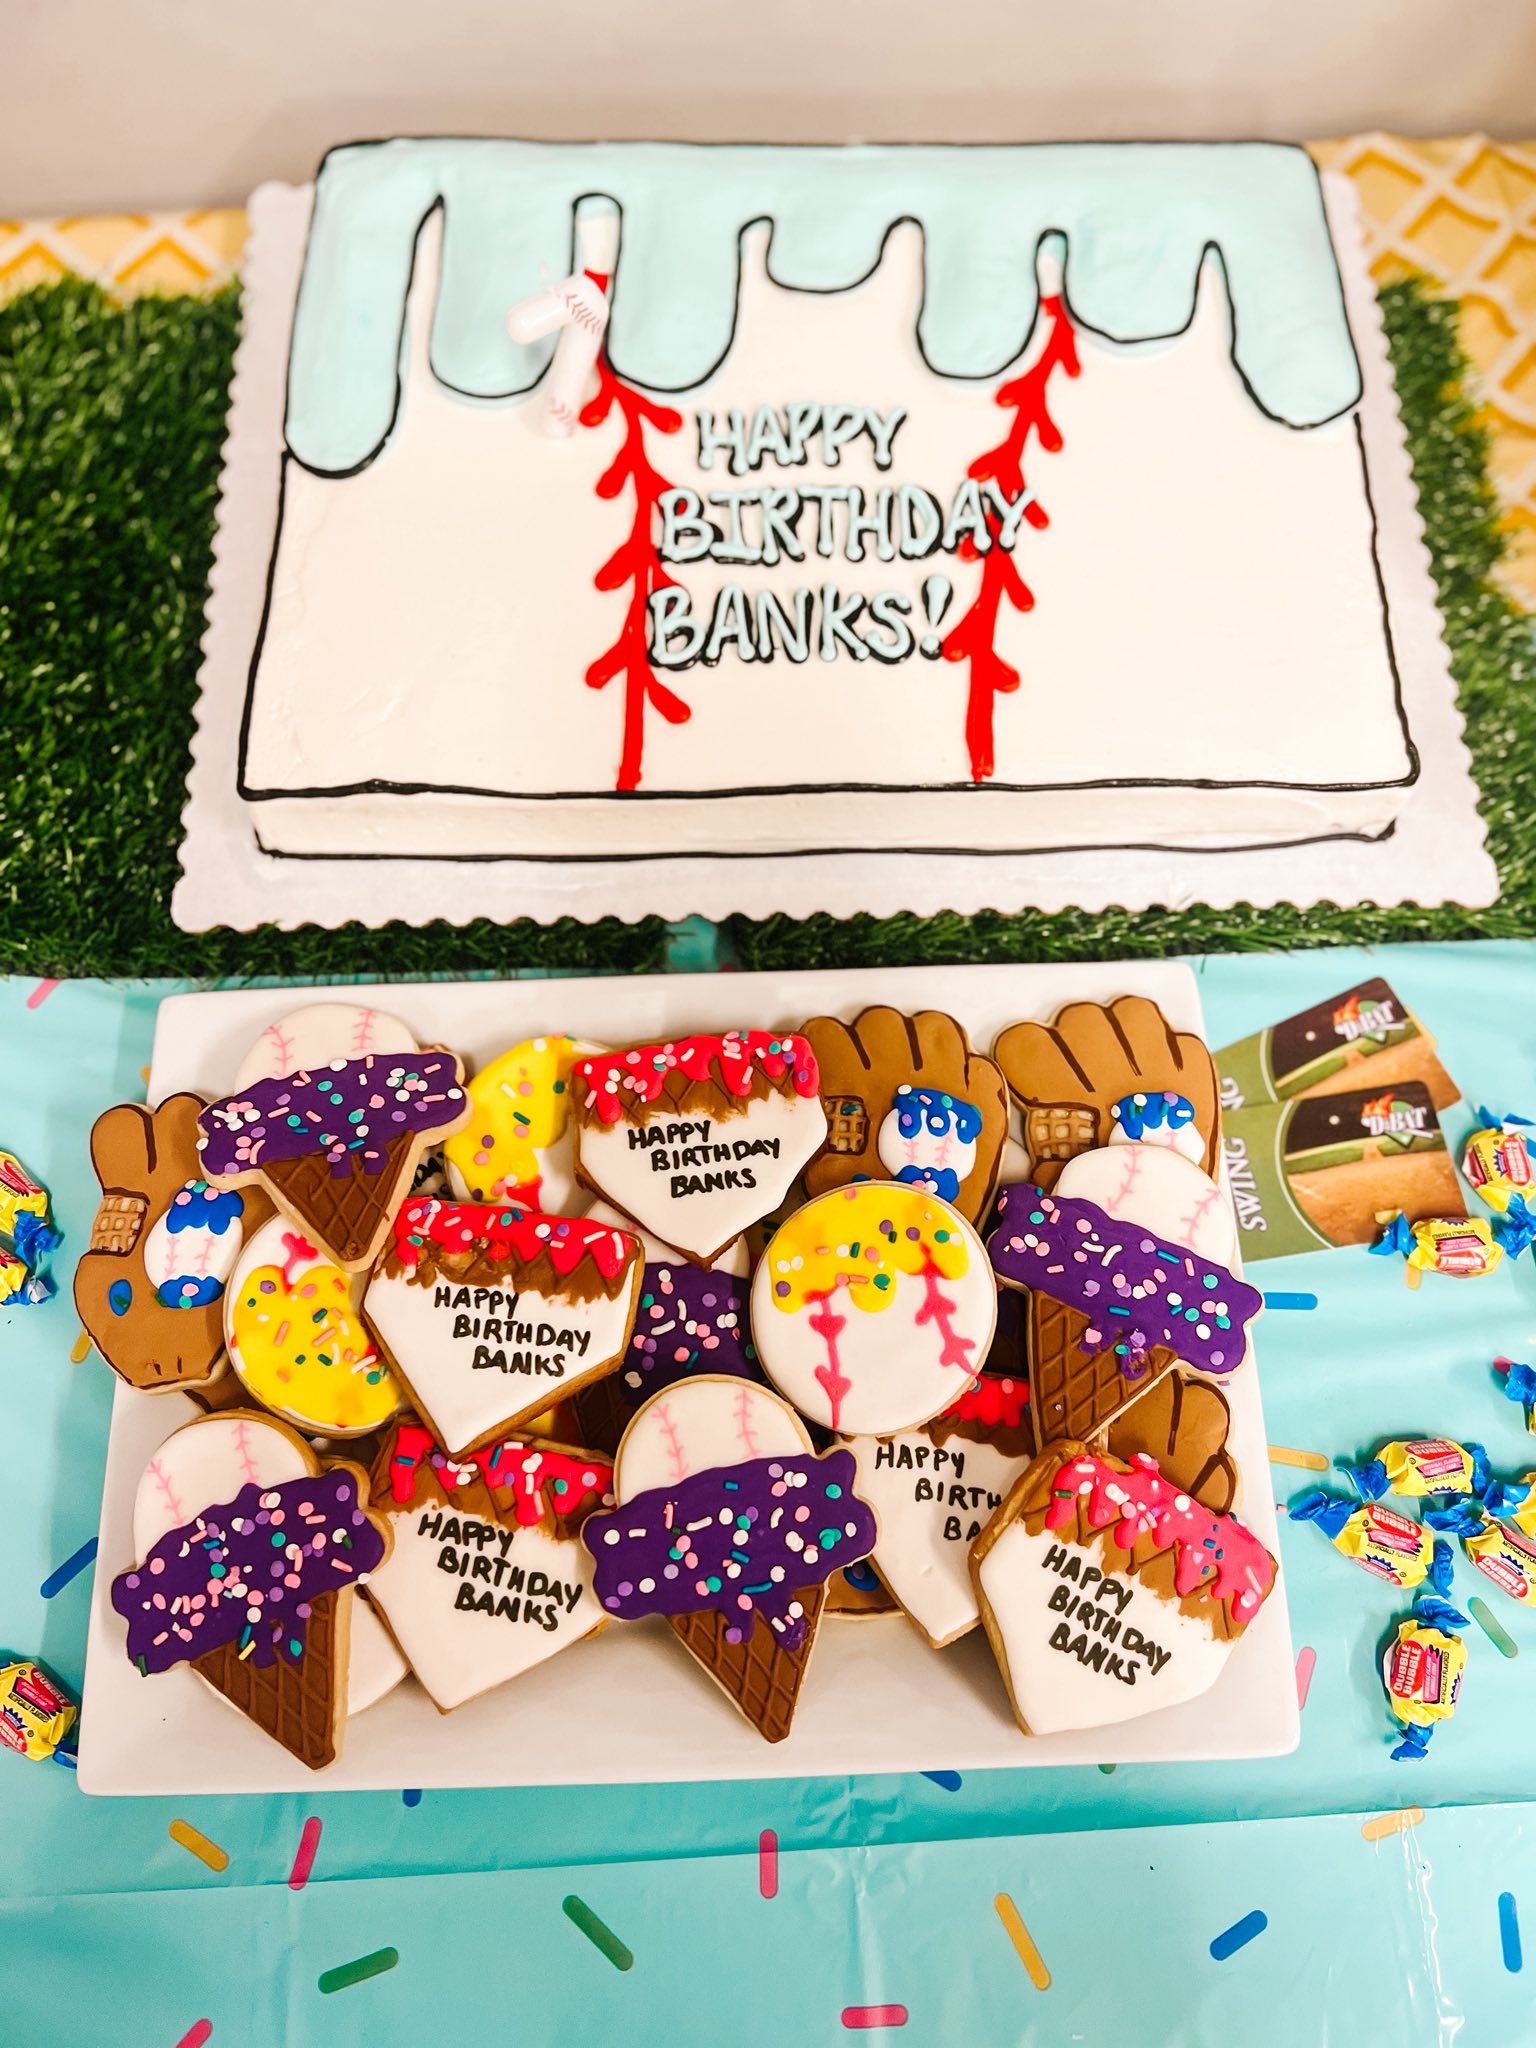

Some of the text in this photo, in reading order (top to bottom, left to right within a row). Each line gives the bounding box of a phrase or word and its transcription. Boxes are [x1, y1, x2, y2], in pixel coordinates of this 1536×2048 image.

[697, 401, 907, 475] HAPPY
[657, 478, 1038, 567] BIRTHDAY
[647, 574, 953, 670] BANKS!
[627, 1120, 711, 1150] HAPPY
[650, 1137, 780, 1171] BIRTHDAY
[670, 1167, 757, 1198] BANKS
[1224, 1137, 1268, 1232] SWING
[434, 1286, 520, 1319] HAPPY
[452, 1314, 591, 1356] BIRTHDAY
[472, 1345, 566, 1377] BANKS
[875, 1441, 965, 1478] HAPPY
[417, 1512, 514, 1557] HAPPY
[1372, 1510, 1417, 1536] BUBBLE
[437, 1546, 583, 1613] BIRTHDAY
[1041, 1544, 1133, 1616] HAPPY
[1481, 1556, 1526, 1591] DUBBLE
[454, 1582, 558, 1631] BANKS
[1048, 1585, 1172, 1676] BIRTHDAY
[1049, 1622, 1140, 1685] BANKS
[32, 1671, 67, 1705] BUBBLE
[1393, 1644, 1411, 1691] DUBBLE
[1402, 1646, 1422, 1695] BUBBLE
